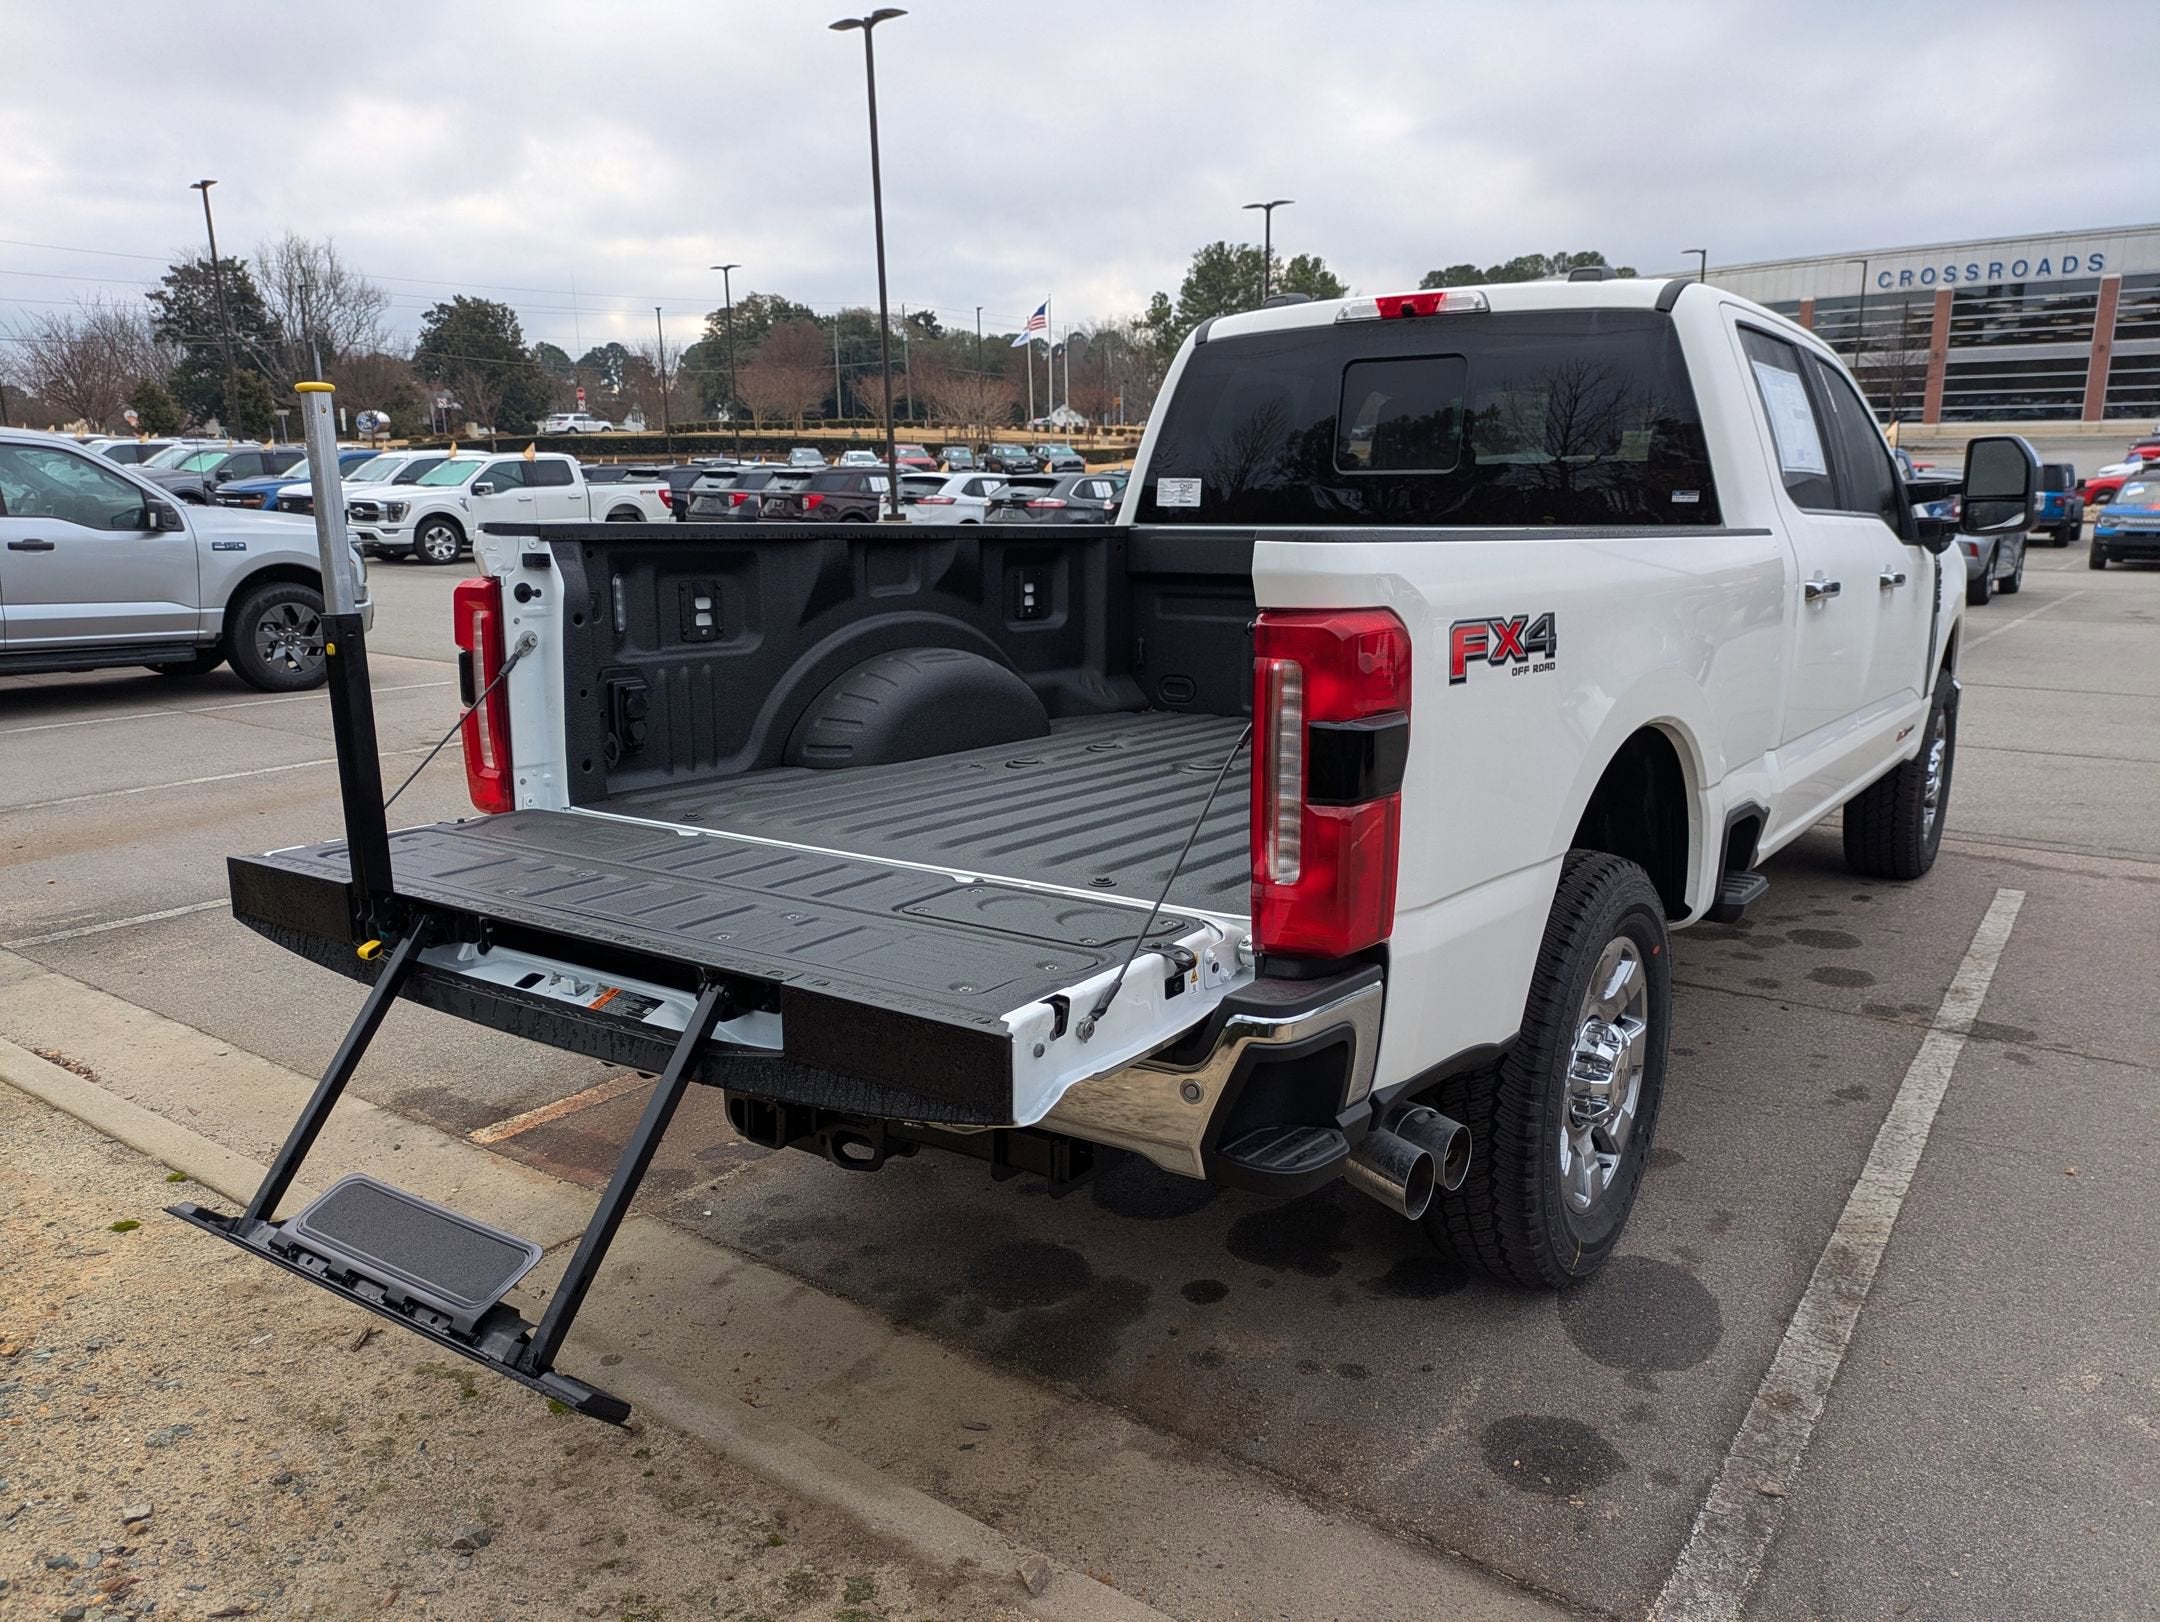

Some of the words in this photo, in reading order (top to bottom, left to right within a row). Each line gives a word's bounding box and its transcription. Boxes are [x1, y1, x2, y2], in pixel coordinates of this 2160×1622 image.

[1877, 252, 2106, 289] CROSSROADS
[1449, 611, 1557, 686] FX4
[1511, 665, 1530, 676] OFF
[1532, 662, 1556, 673] ROAD
